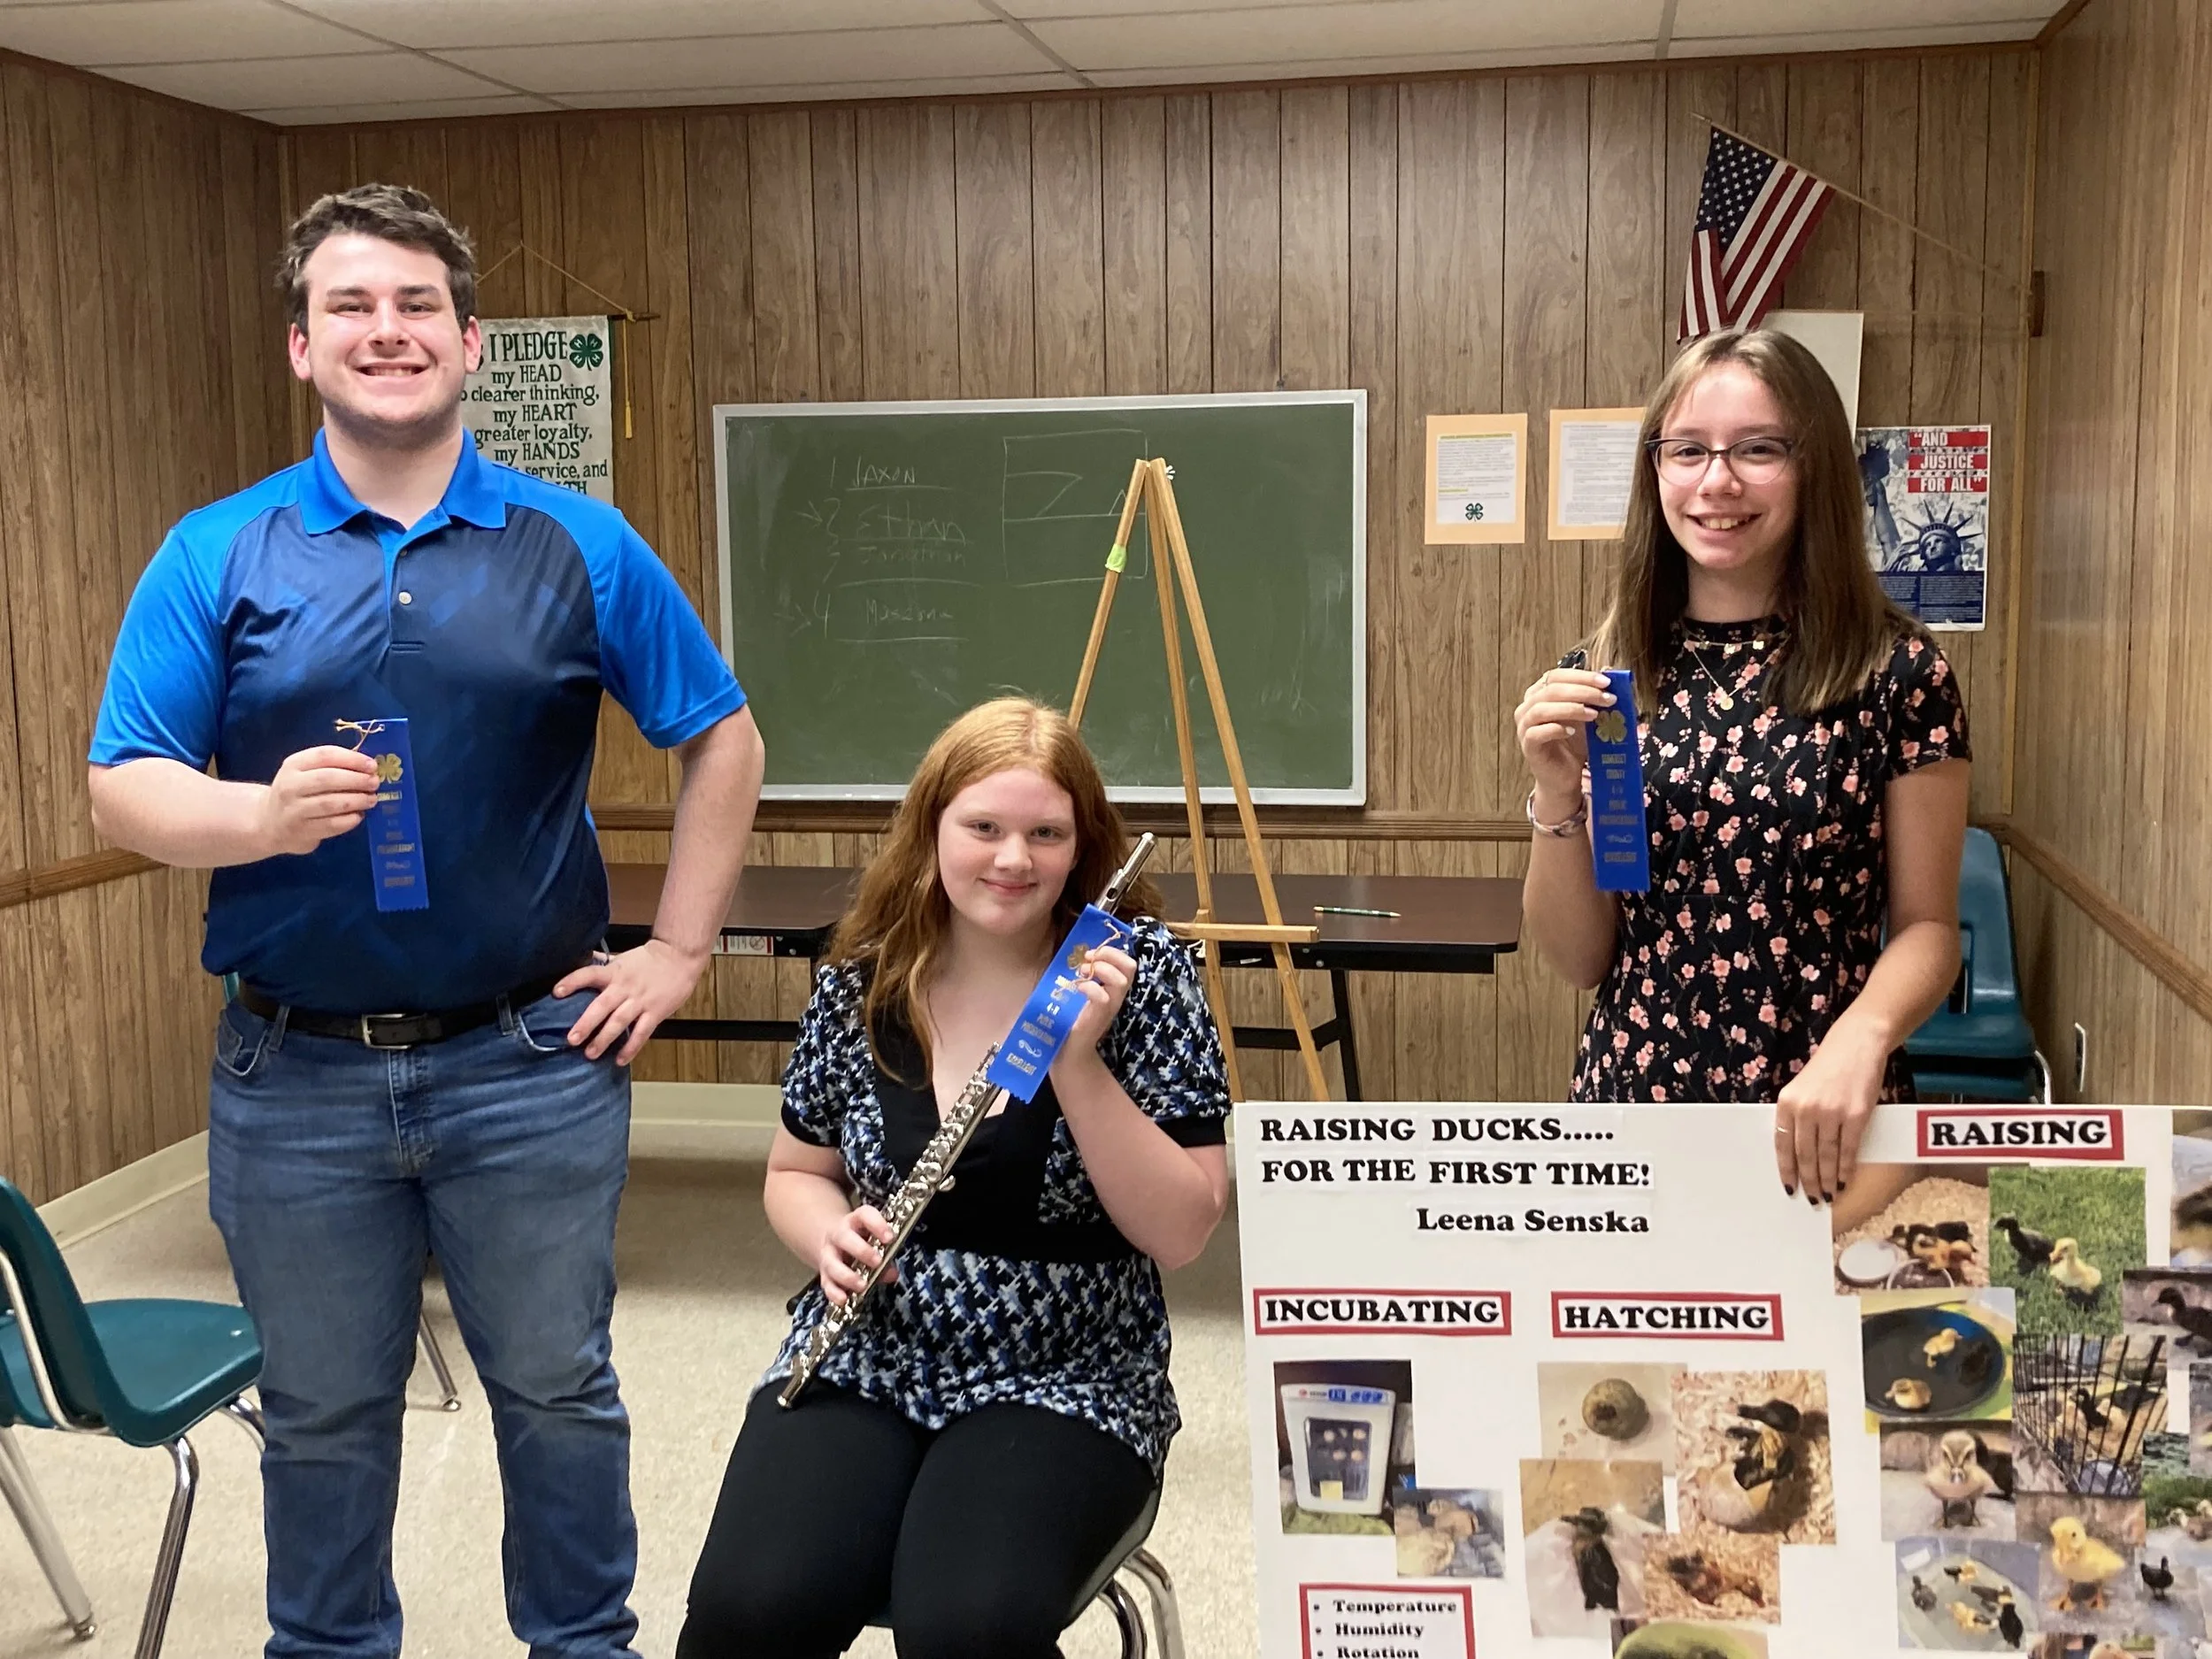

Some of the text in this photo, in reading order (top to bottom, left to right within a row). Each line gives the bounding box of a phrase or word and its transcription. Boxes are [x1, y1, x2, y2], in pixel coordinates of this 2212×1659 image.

[488, 331, 568, 362] I PLEDGE
[492, 365, 563, 388] my HEAD
[472, 385, 526, 402] clearer
[531, 382, 600, 407] thinking,
[493, 403, 577, 427] my HEART
[474, 424, 593, 449] greater loyalty,
[494, 442, 580, 466] my HANDS
[1920, 454, 1974, 470] JUSTICE
[525, 463, 580, 480] service,
[583, 459, 608, 477] and
[1920, 478, 1946, 492] FOR
[1260, 1118, 1614, 1141] RAISING DUCKS.....
[1932, 1120, 2107, 1146] RAISING
[1262, 1160, 1650, 1187] FOR THE FIRST TIME!
[1417, 1209, 1649, 1233] Leena Senska
[1265, 1299, 1500, 1325] INCUBATING
[1564, 1306, 1769, 1330] HATCHING
[1333, 1600, 1456, 1615] Temperature
[1335, 1623, 1424, 1637] Humidity
[1337, 1647, 1419, 1659] Rotation
